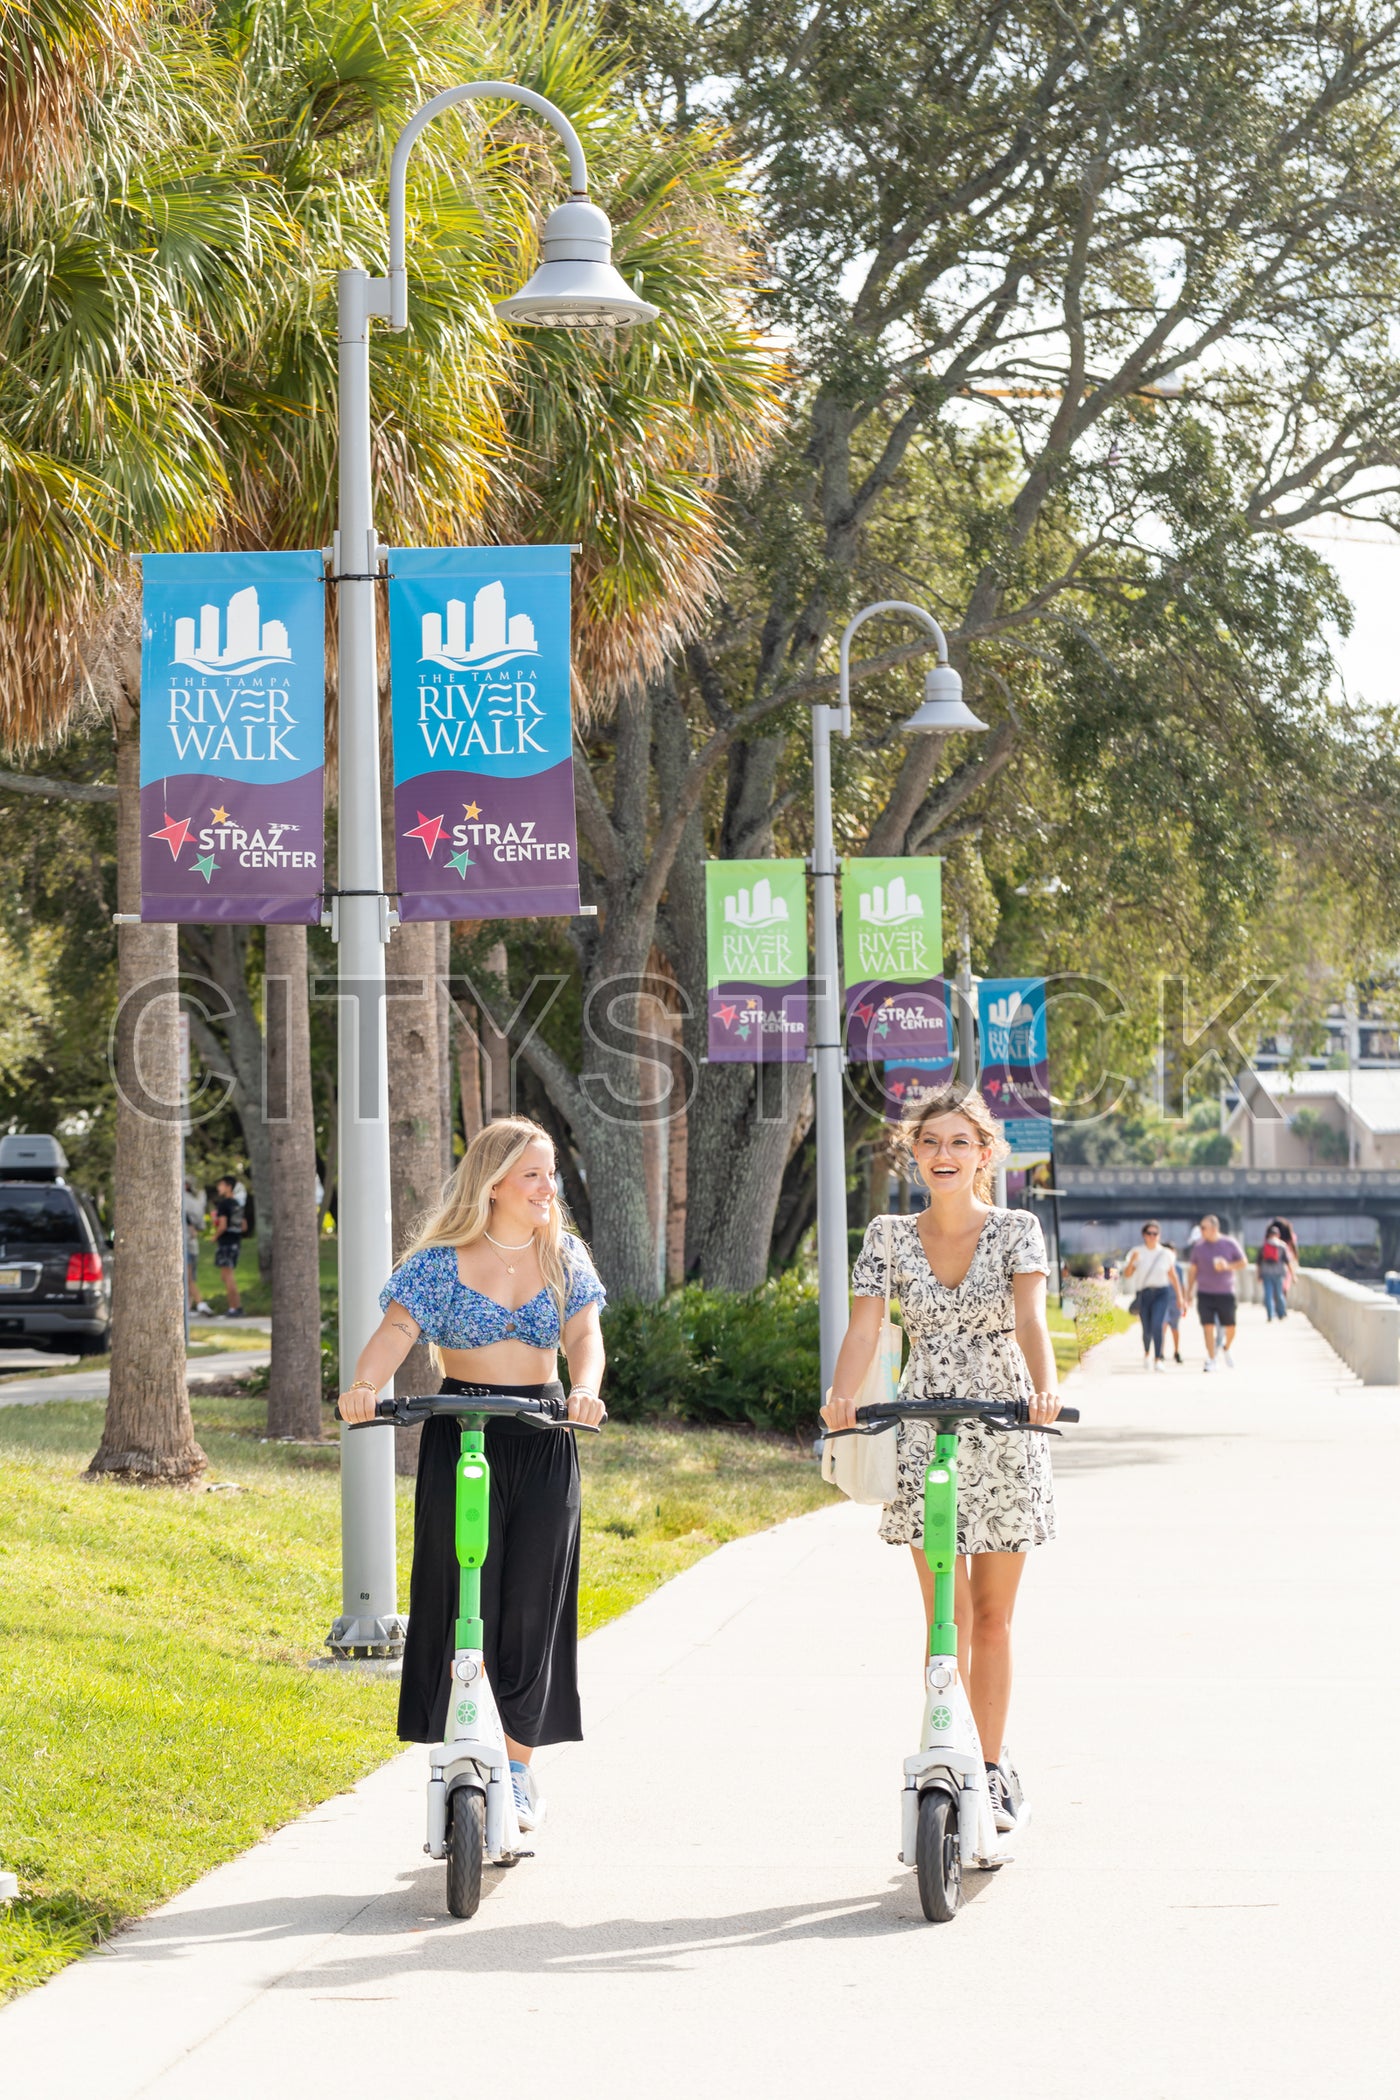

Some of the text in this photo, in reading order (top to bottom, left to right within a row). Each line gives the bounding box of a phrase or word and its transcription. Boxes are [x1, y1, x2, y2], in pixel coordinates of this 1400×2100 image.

[170, 677, 292, 687] THE TAMPA
[418, 670, 538, 684] THE TAMPA
[168, 688, 299, 724] RIVER
[417, 681, 547, 721] RIVER
[167, 724, 300, 761] WALK
[417, 717, 549, 758] WALK
[198, 828, 284, 851] STRAZ
[452, 822, 537, 847] STRAZ
[239, 851, 317, 868] CENTER
[493, 843, 571, 862] CENTER
[723, 934, 793, 954] RIVER
[859, 931, 928, 953] RIVER
[723, 954, 794, 975] WALK
[859, 951, 930, 974] WALK
[739, 1010, 787, 1024] STRAZ
[877, 1006, 925, 1022] STRAZ
[900, 1017, 944, 1030] CENTER
[761, 1021, 805, 1033] CENTER
